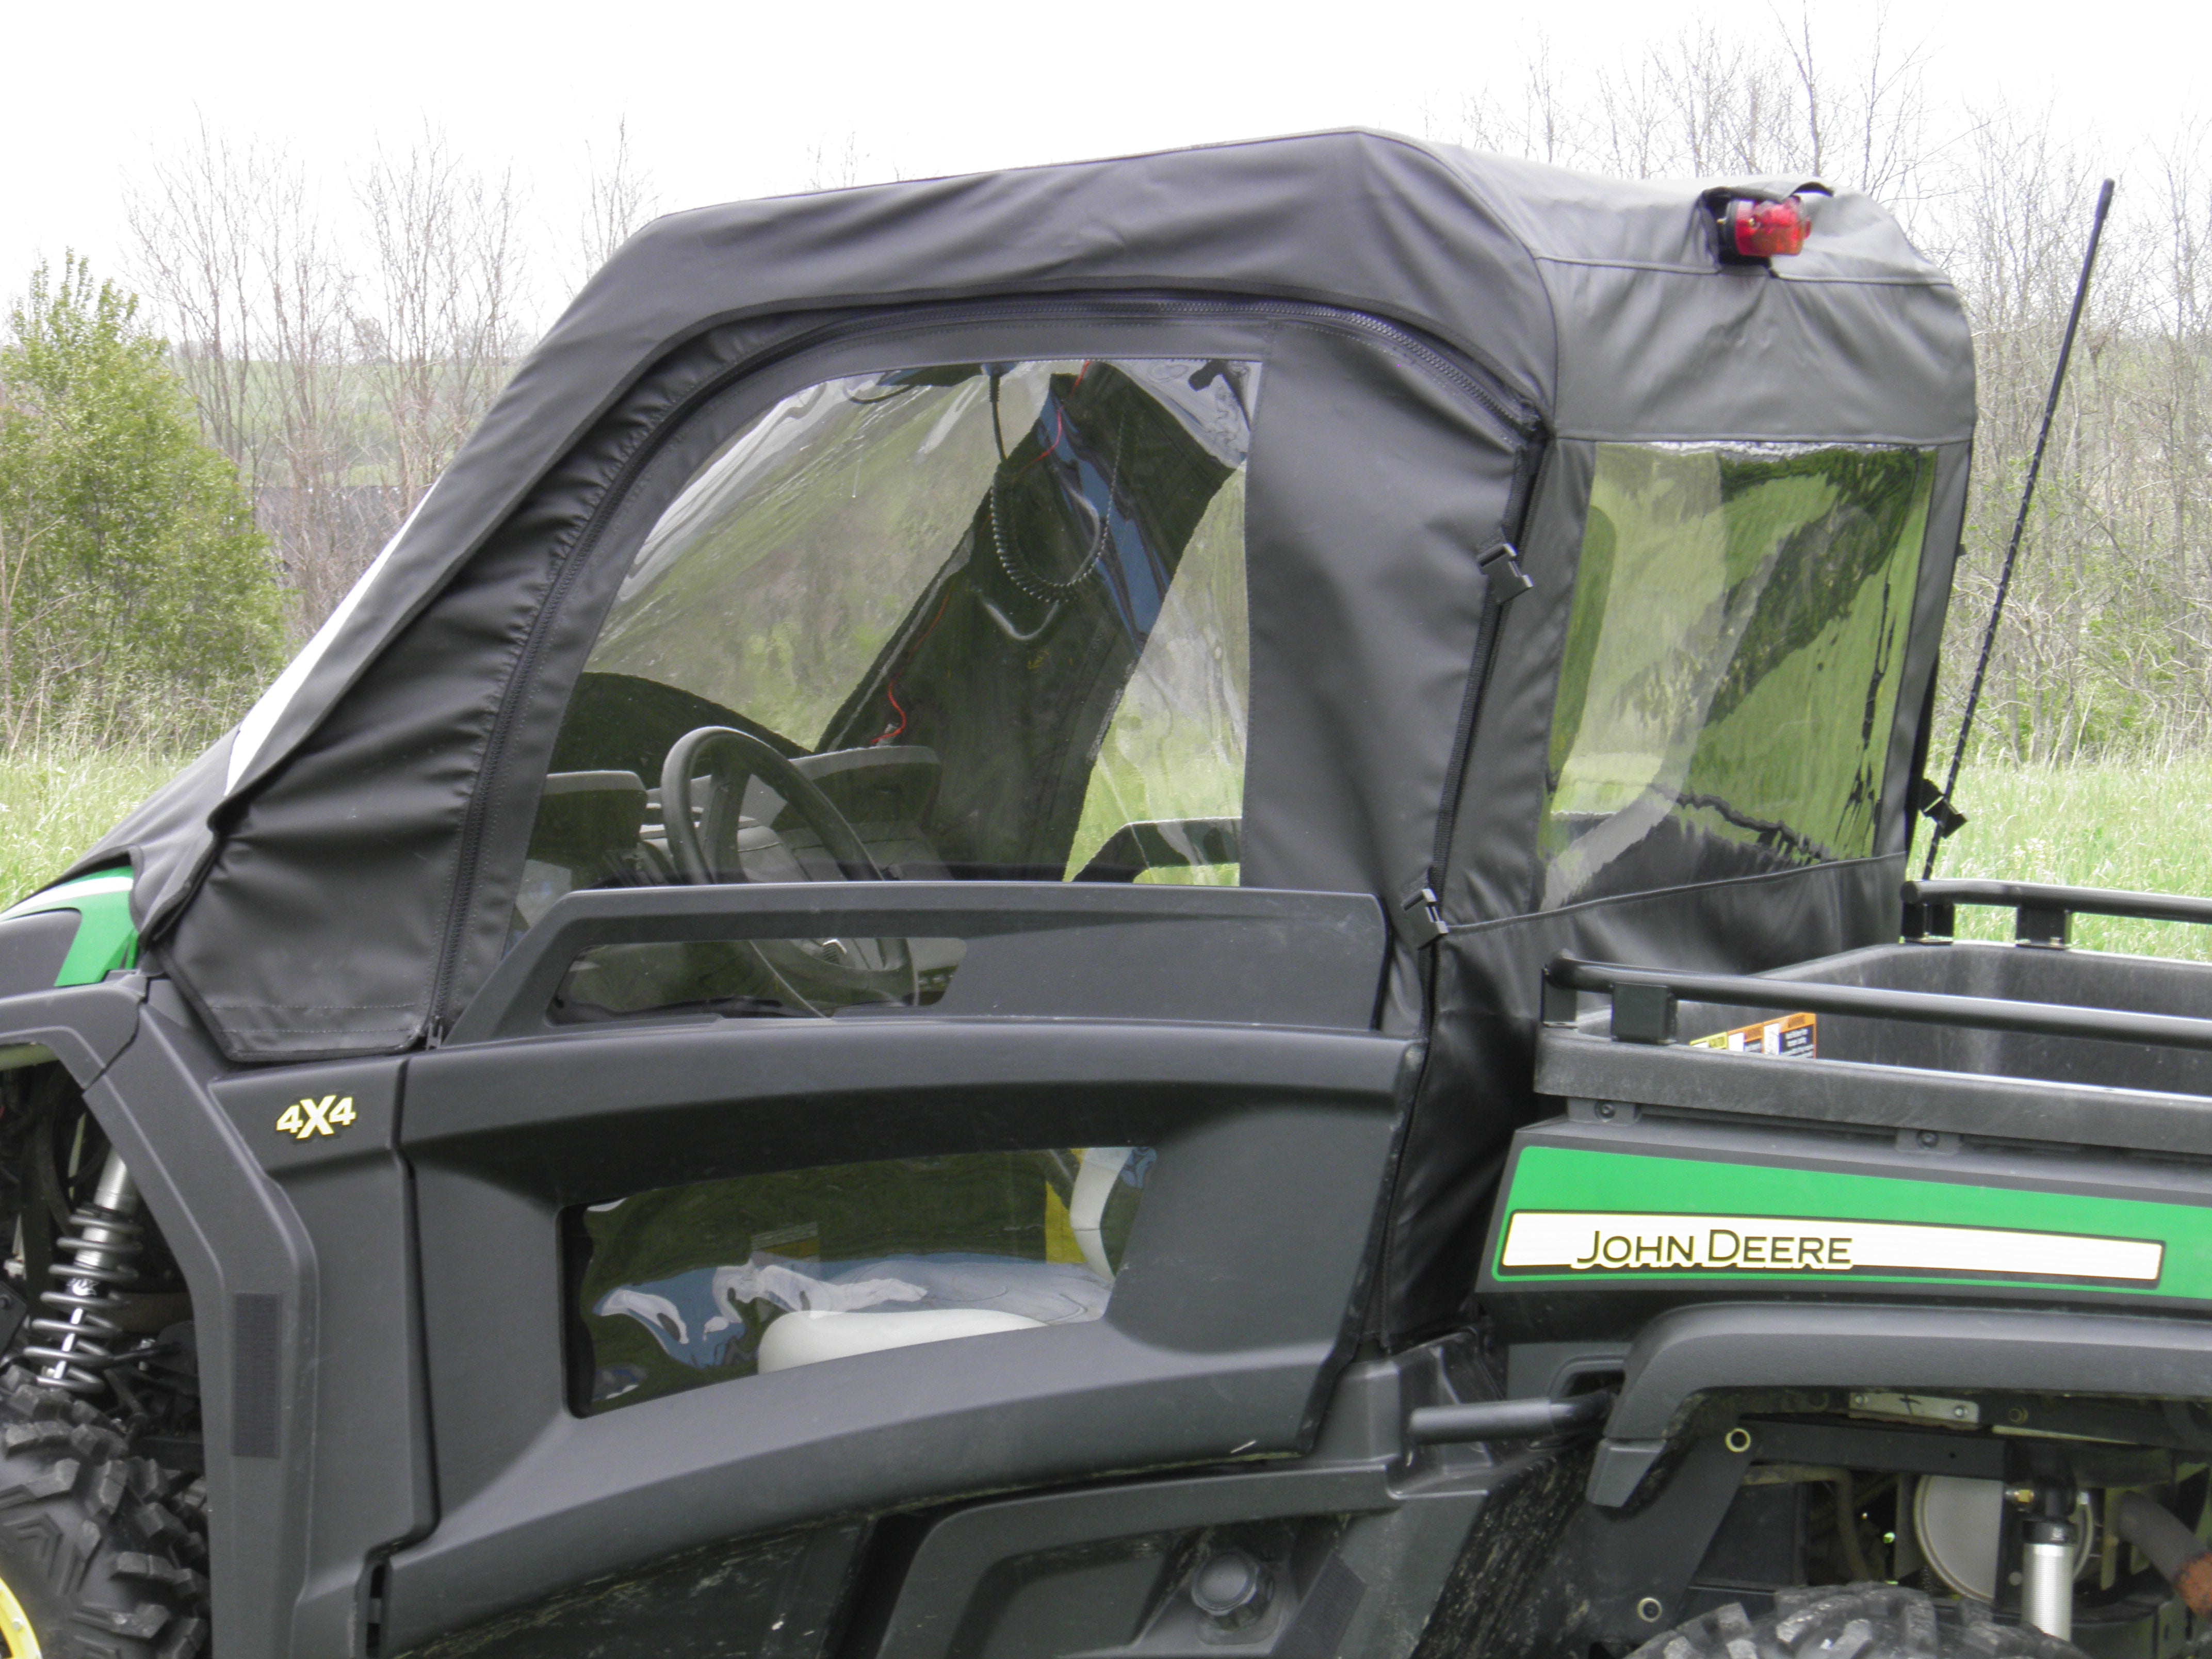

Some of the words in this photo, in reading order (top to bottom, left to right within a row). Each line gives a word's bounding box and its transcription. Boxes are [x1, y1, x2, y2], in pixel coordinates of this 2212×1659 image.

[276, 1095, 356, 1139] 4X4
[1577, 1231, 1694, 1263] JOHN
[1709, 1229, 1852, 1264] DEERE
